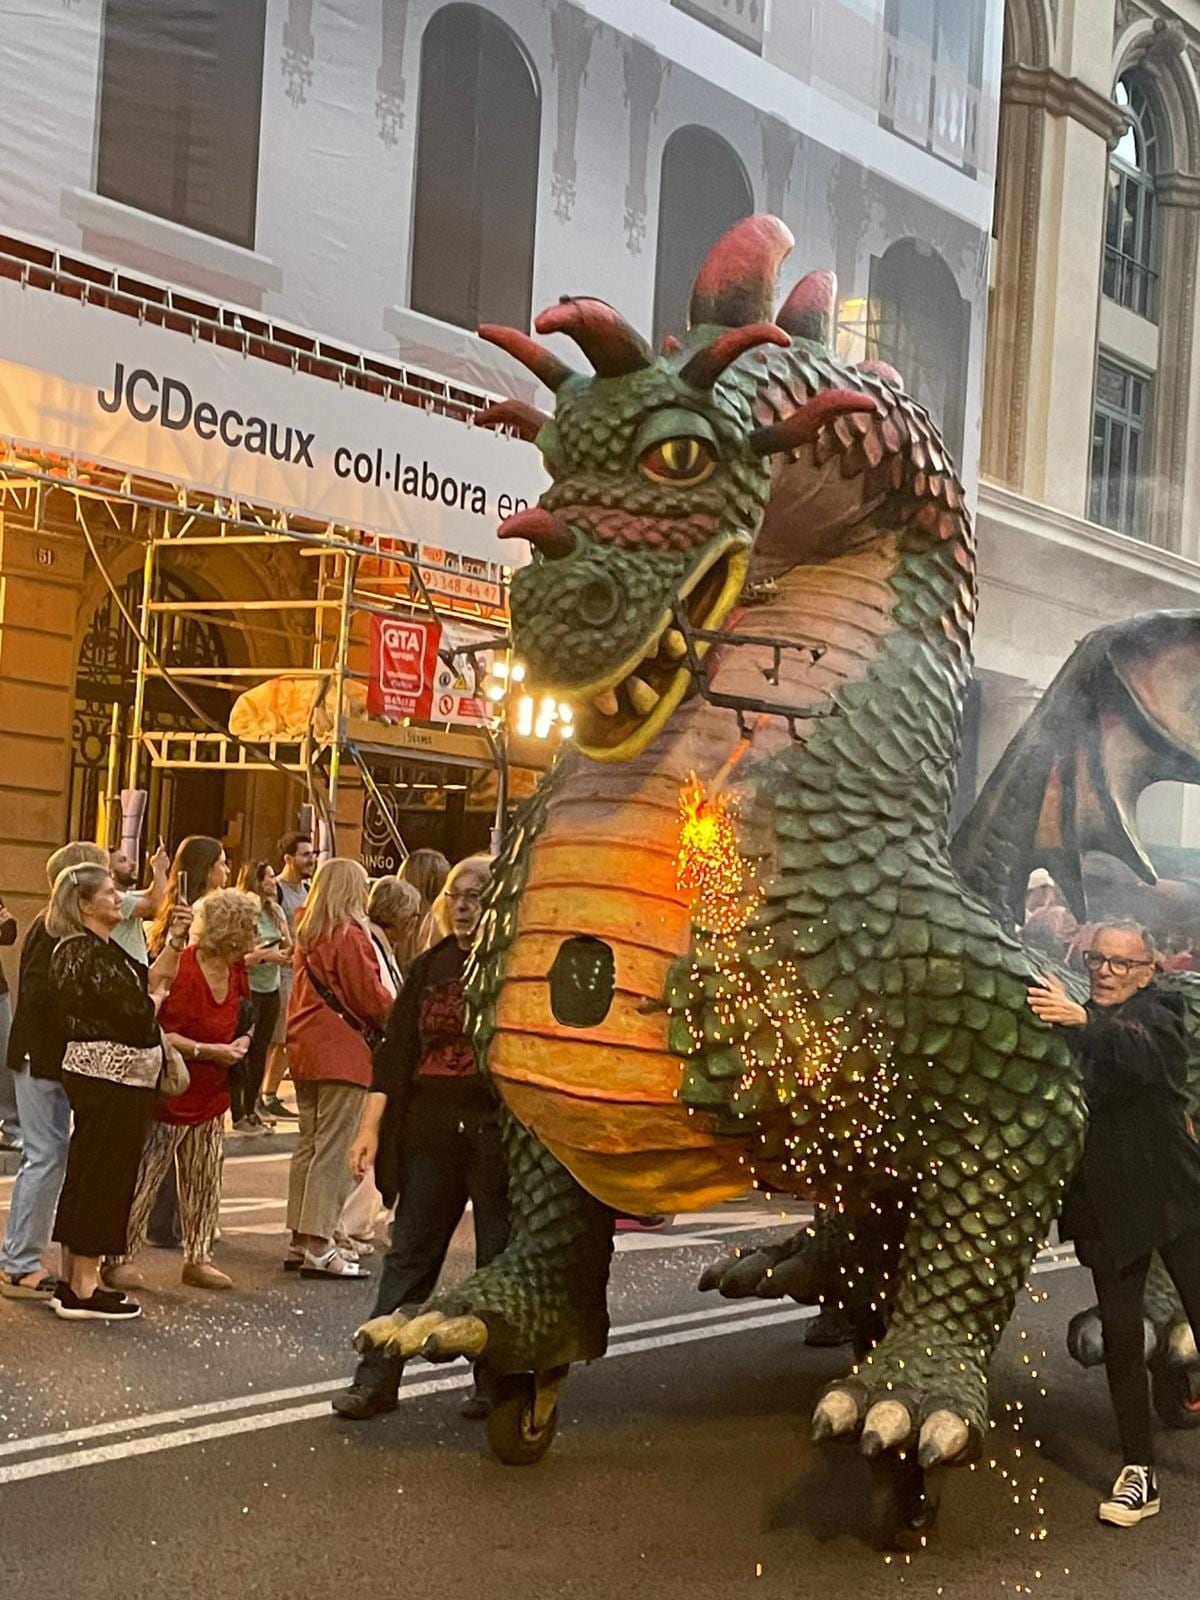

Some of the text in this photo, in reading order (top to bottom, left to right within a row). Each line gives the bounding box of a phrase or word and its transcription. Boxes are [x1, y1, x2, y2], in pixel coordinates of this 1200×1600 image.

[97, 362, 316, 469] JCDecaux
[334, 446, 487, 516] col·labora
[38, 548, 52, 565] 51
[385, 628, 420, 652] GTA
